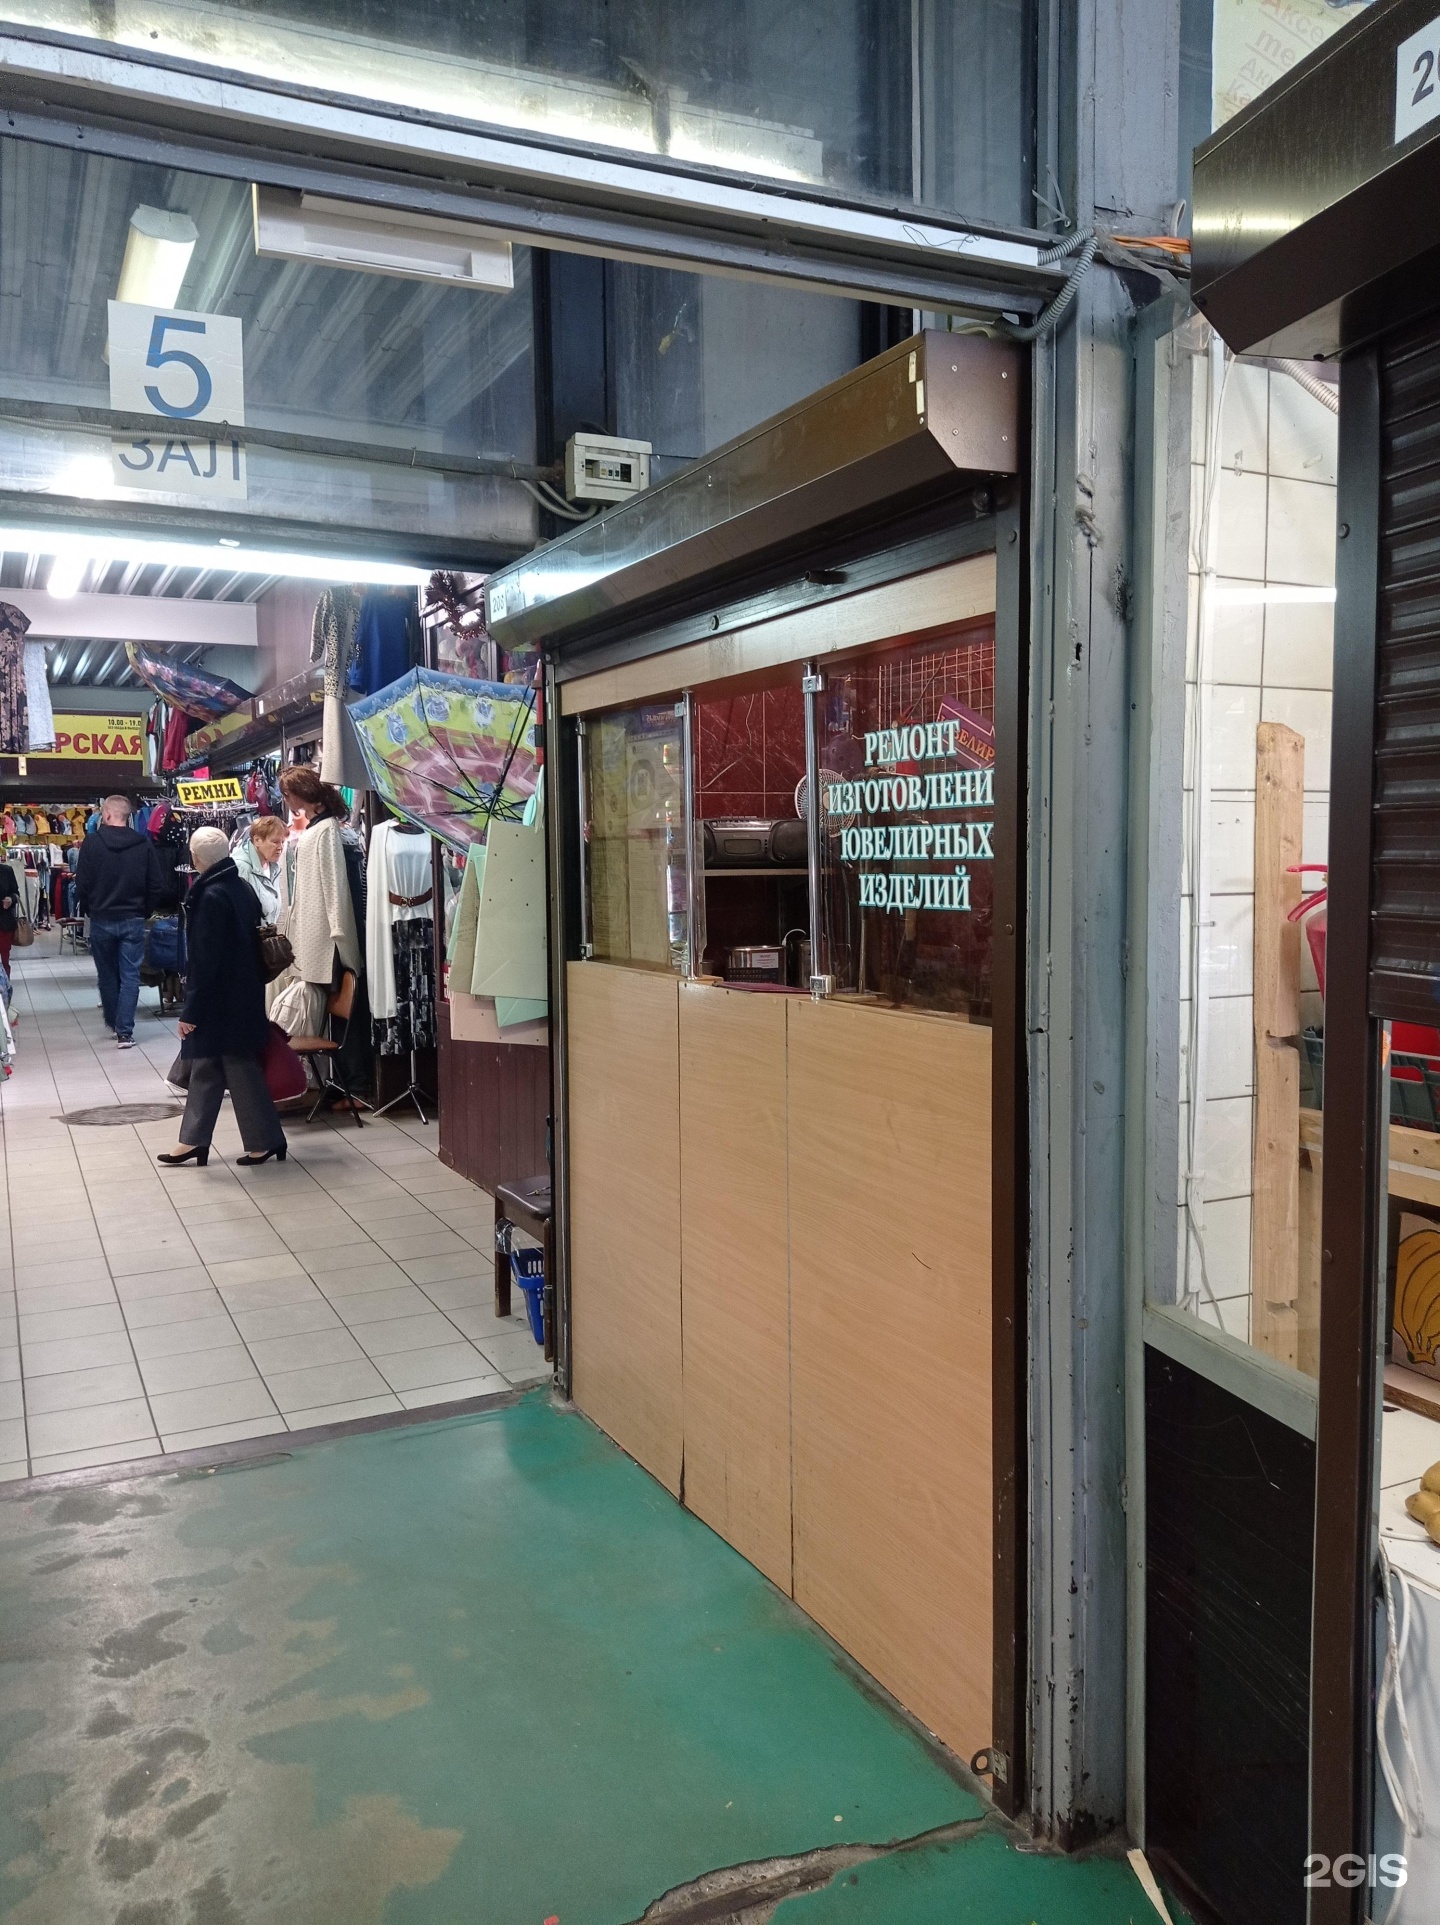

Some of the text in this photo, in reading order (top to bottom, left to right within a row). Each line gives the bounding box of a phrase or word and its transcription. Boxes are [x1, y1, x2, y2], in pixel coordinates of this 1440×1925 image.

[1411, 50, 1440, 107] 2
[144, 315, 212, 419] 5
[865, 719, 960, 766] РЕМОНТ
[181, 783, 238, 801] РЕМНИ
[827, 768, 995, 816] ИЗГОТОВЛЕНИ
[840, 822, 995, 861] ЮВЕЛИРНЫХ
[858, 865, 971, 916] ИЗДЕЛИЙ
